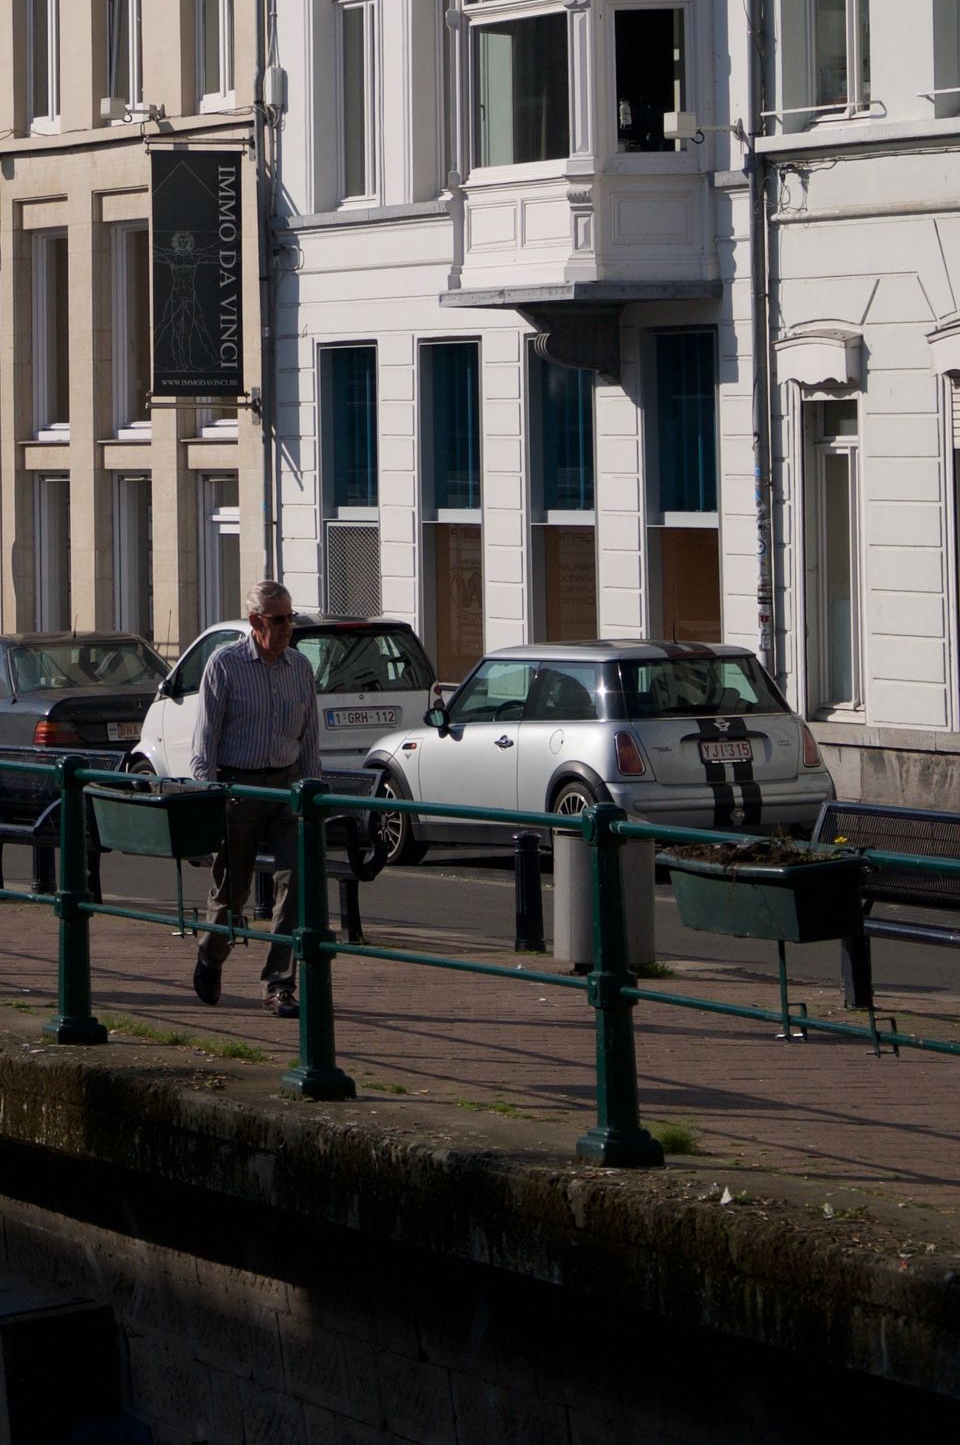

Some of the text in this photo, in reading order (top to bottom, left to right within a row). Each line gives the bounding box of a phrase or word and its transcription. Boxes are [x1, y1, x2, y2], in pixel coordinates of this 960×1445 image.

[218, 165, 238, 370] IMMO DA VINCI
